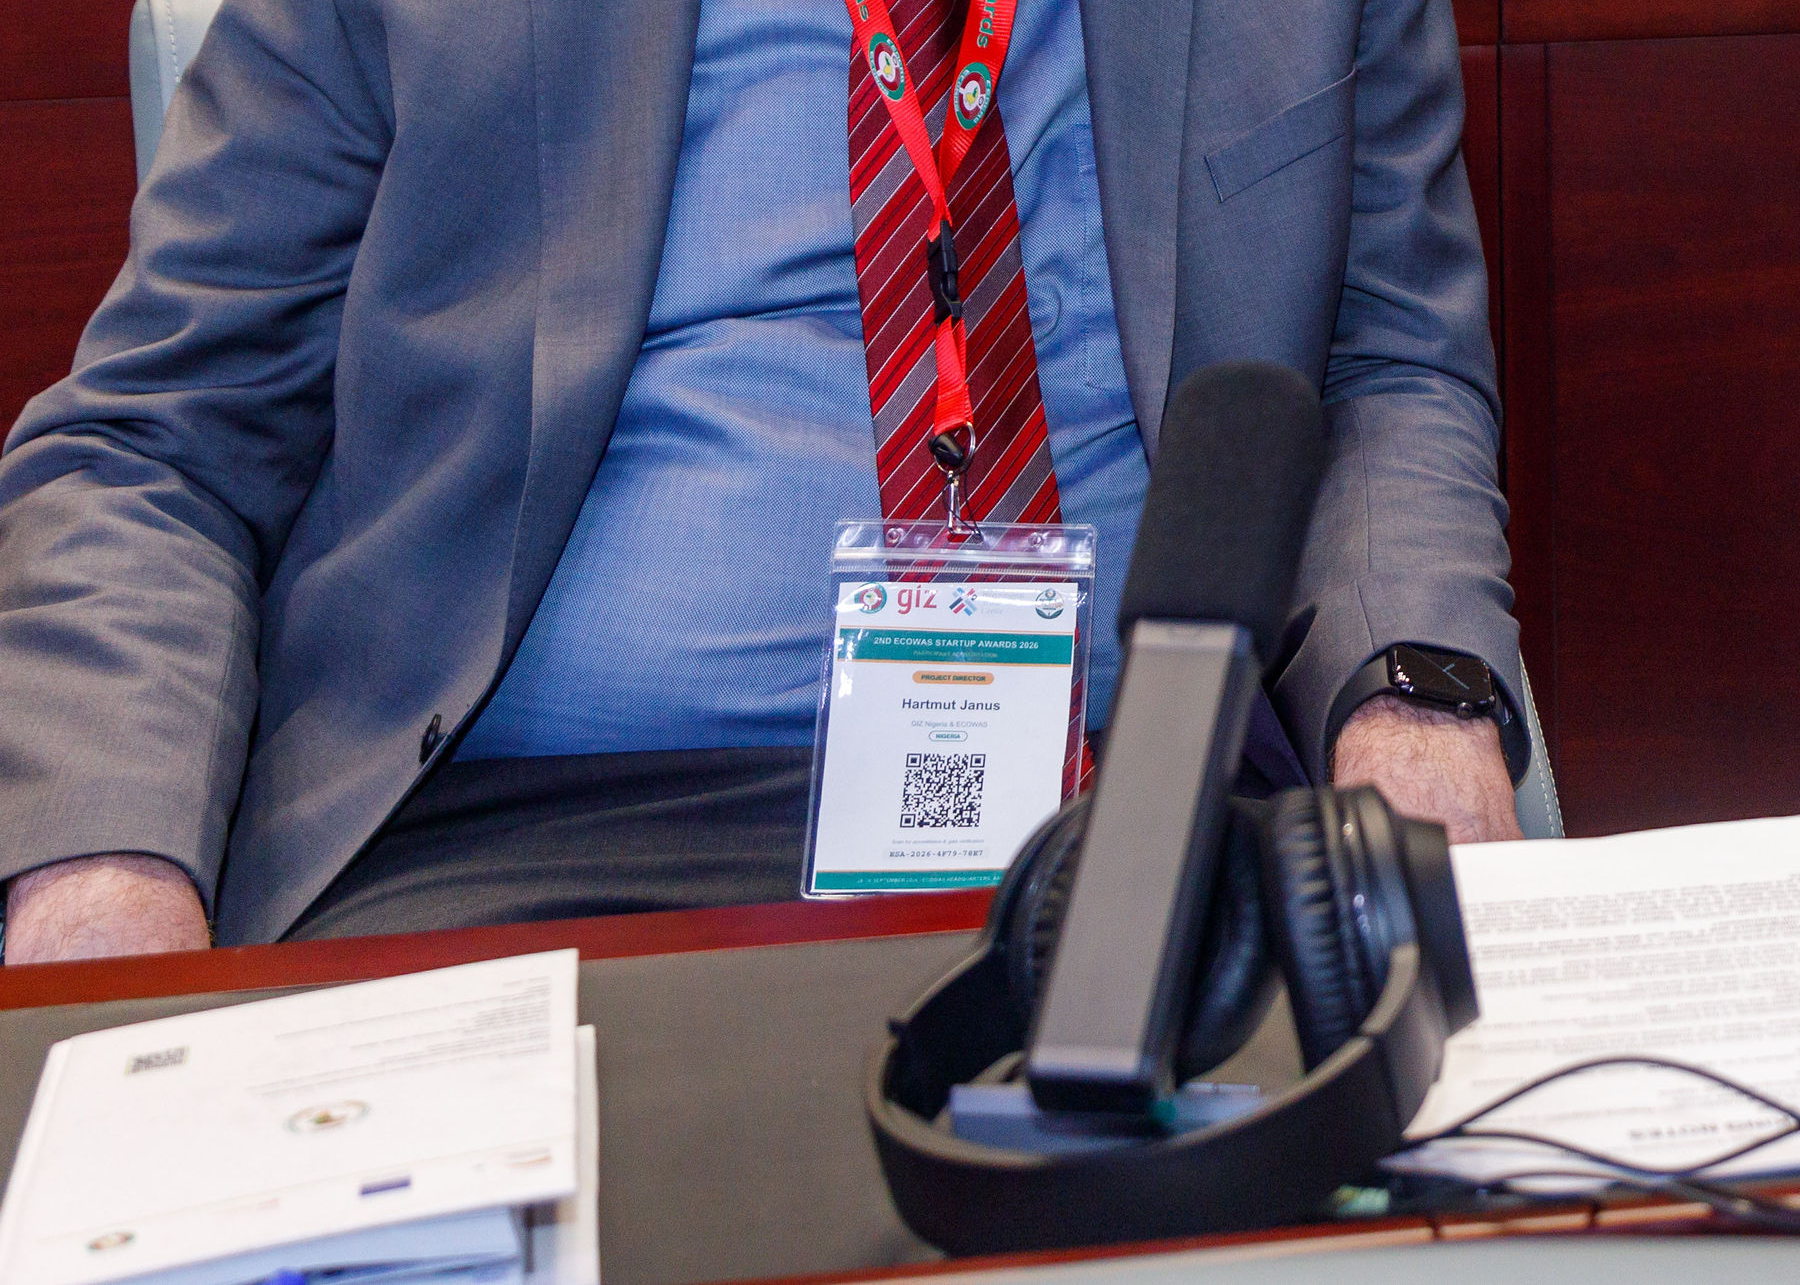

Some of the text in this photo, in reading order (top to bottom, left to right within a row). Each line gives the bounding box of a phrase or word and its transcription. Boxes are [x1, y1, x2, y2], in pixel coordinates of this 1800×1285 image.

[897, 584, 937, 614] giz
[873, 636, 891, 645] 2ND
[893, 637, 933, 646] ECOWAS
[935, 638, 976, 648] STARTUP
[978, 639, 1018, 649] AWARDS
[902, 698, 1001, 711] Hartmut Janus
